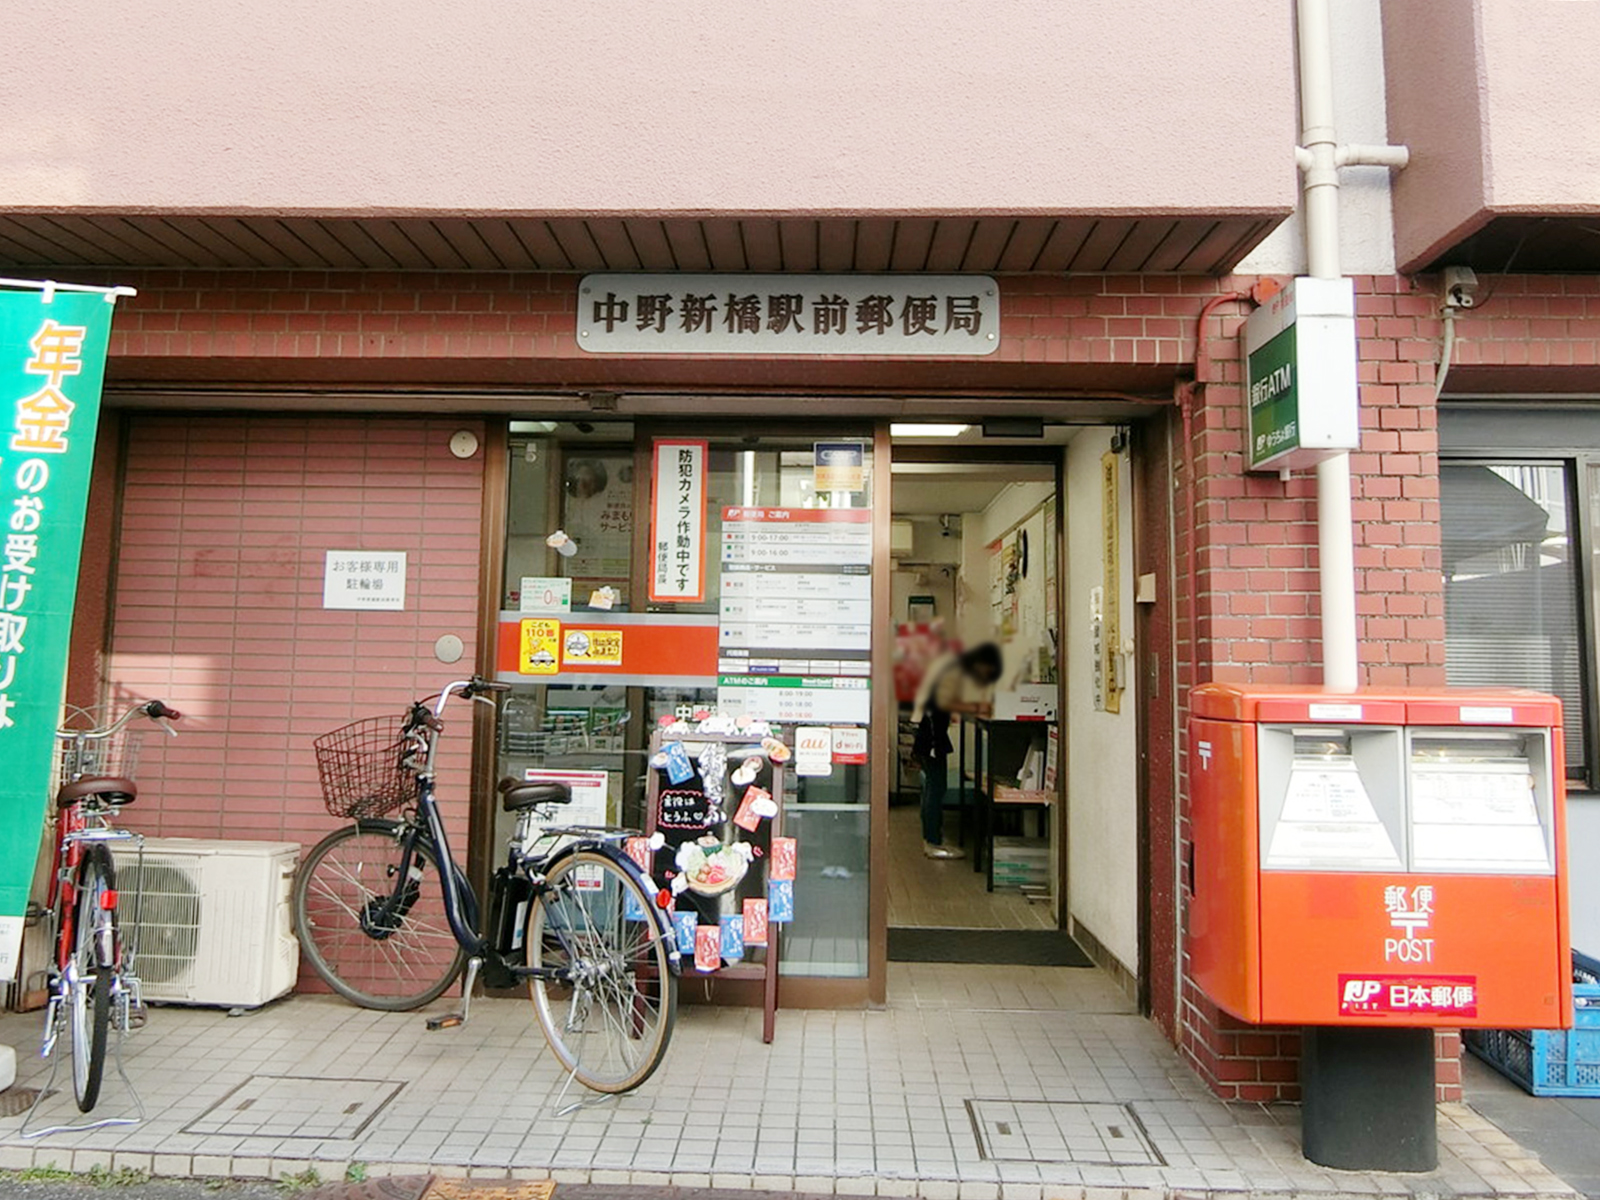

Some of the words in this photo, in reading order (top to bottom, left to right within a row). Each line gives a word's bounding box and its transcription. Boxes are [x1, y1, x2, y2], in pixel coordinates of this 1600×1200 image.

[593, 293, 983, 337] 中野新橋駅前郵便局
[675, 449, 694, 592] 防犯カメラ作動中です
[333, 560, 399, 573] お客様専用
[346, 578, 384, 590] 駐輪場
[801, 739, 826, 749] au
[1384, 885, 1434, 913] 郵便
[1384, 938, 1434, 962] POST
[1389, 984, 1474, 1008] 日本郵便
